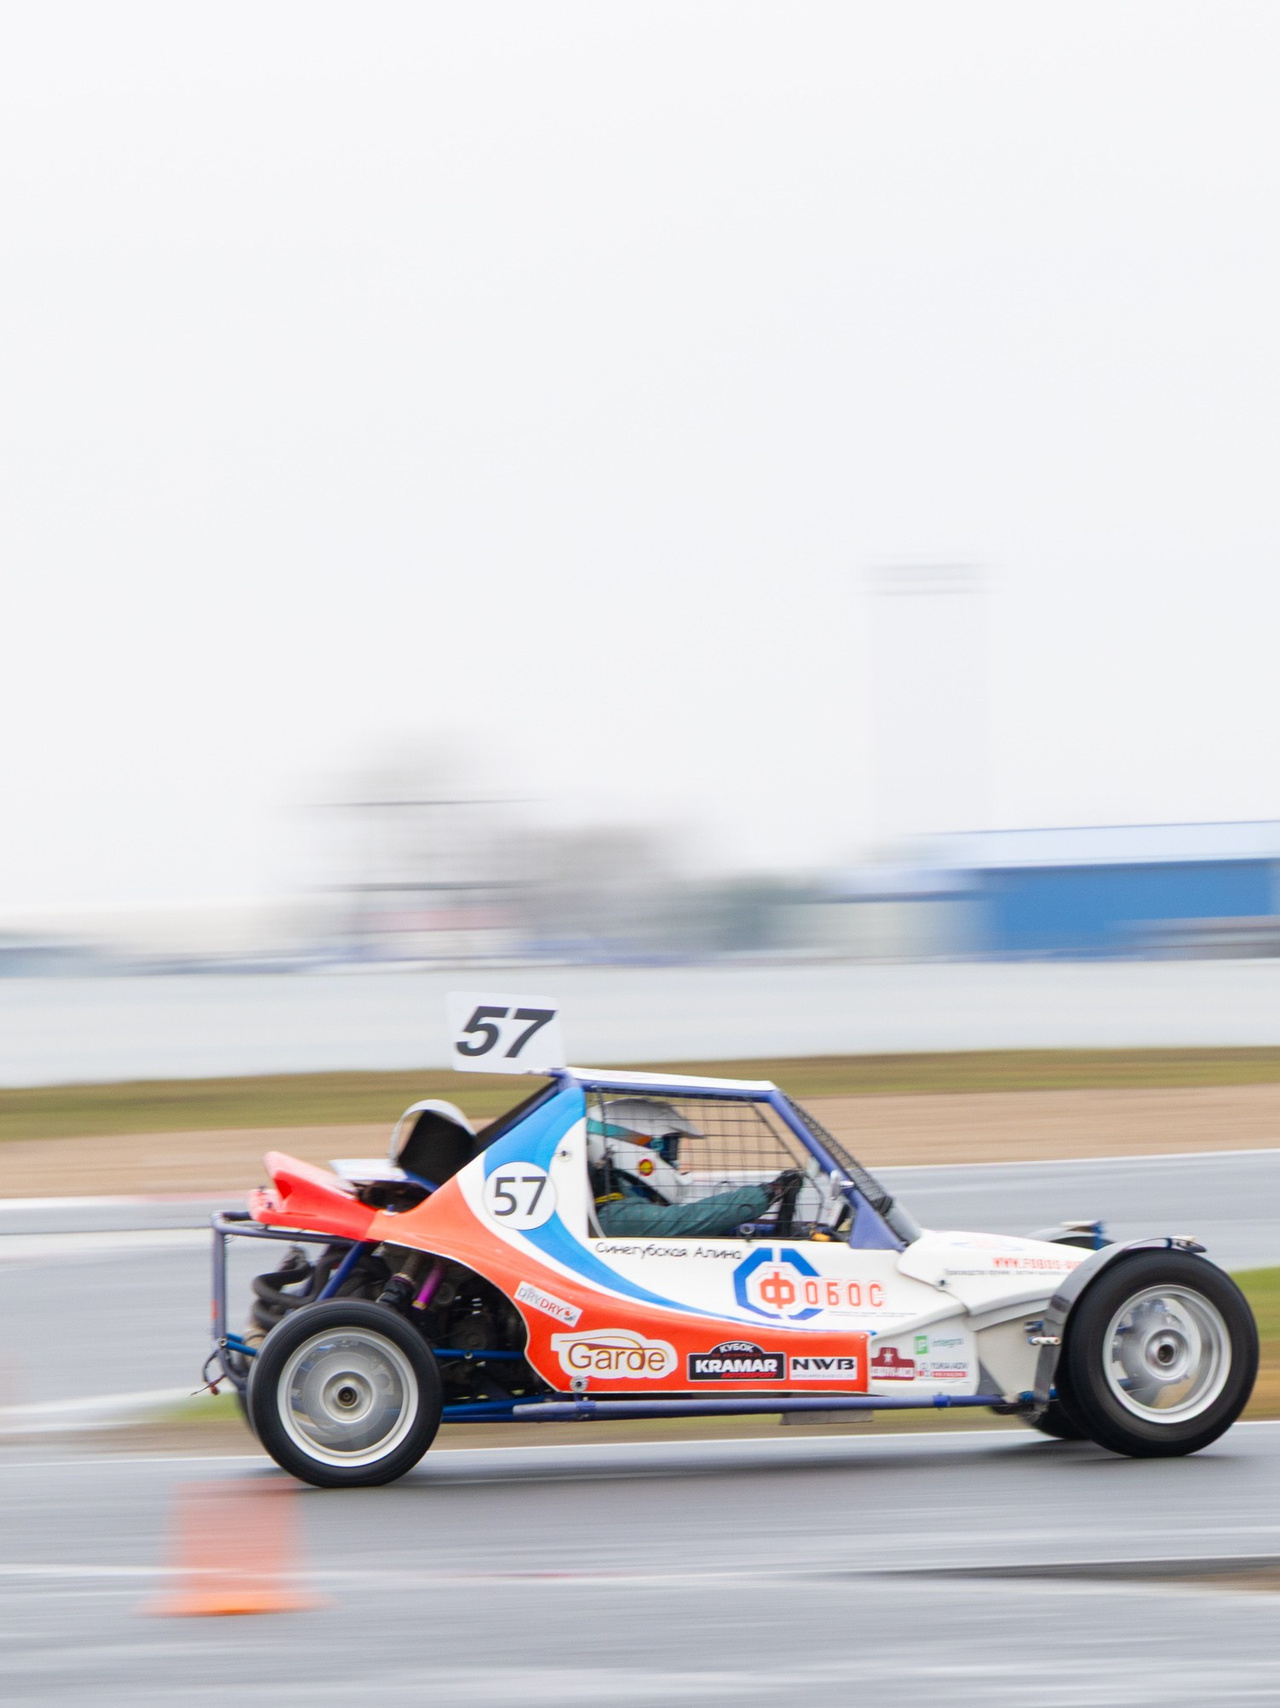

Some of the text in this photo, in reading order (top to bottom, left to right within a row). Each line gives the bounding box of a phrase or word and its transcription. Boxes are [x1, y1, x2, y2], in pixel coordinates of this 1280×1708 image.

[455, 1005, 557, 1058] 57
[494, 1176, 547, 1216] 57
[595, 1242, 742, 1260] Синегубская Алина
[759, 1271, 883, 1309] ФОБОС
[568, 1341, 666, 1371] Garde
[719, 1343, 755, 1353] КУБОК
[695, 1359, 778, 1373] KRAMAR
[792, 1358, 855, 1370] NWB
